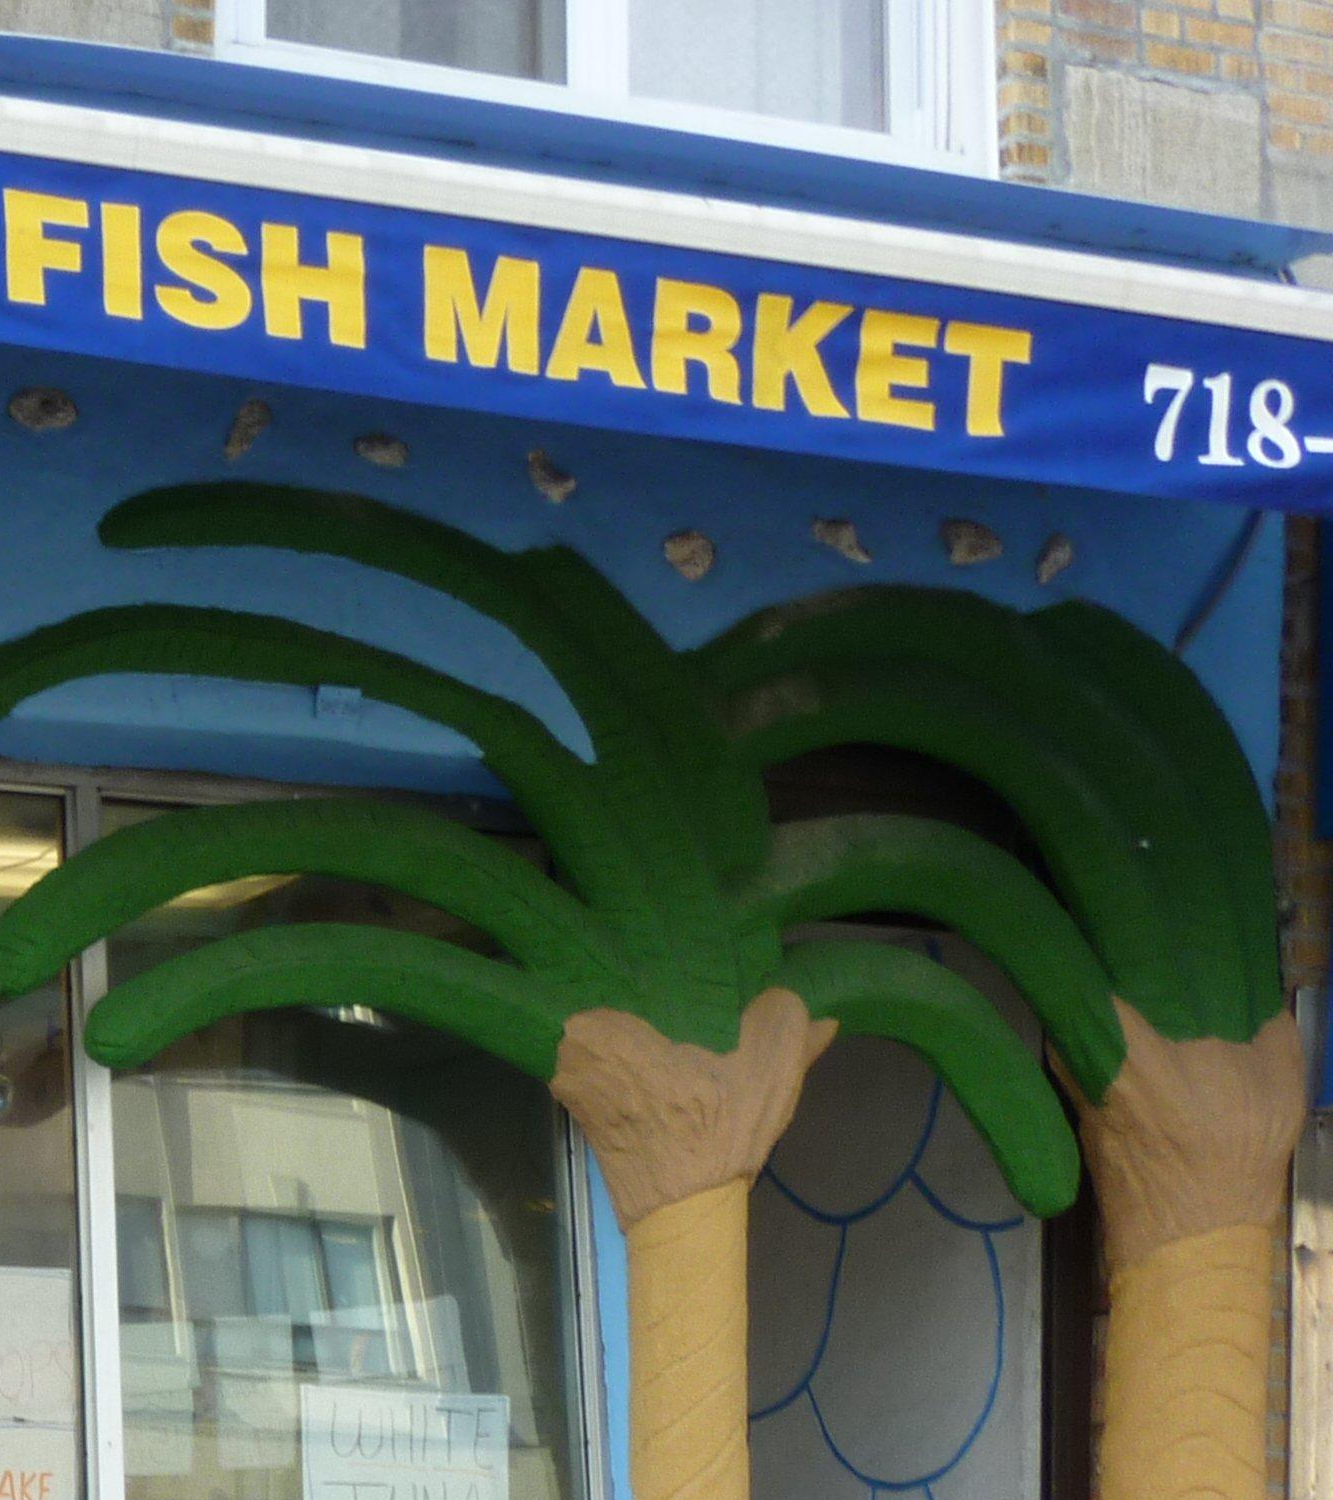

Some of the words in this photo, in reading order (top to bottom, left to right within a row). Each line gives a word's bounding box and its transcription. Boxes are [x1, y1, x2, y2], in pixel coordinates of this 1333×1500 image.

[3, 189, 367, 350] FISH
[422, 246, 1032, 438] MARKET
[1143, 362, 1333, 469] 718-
[330, 1402, 497, 1470] WHITE
